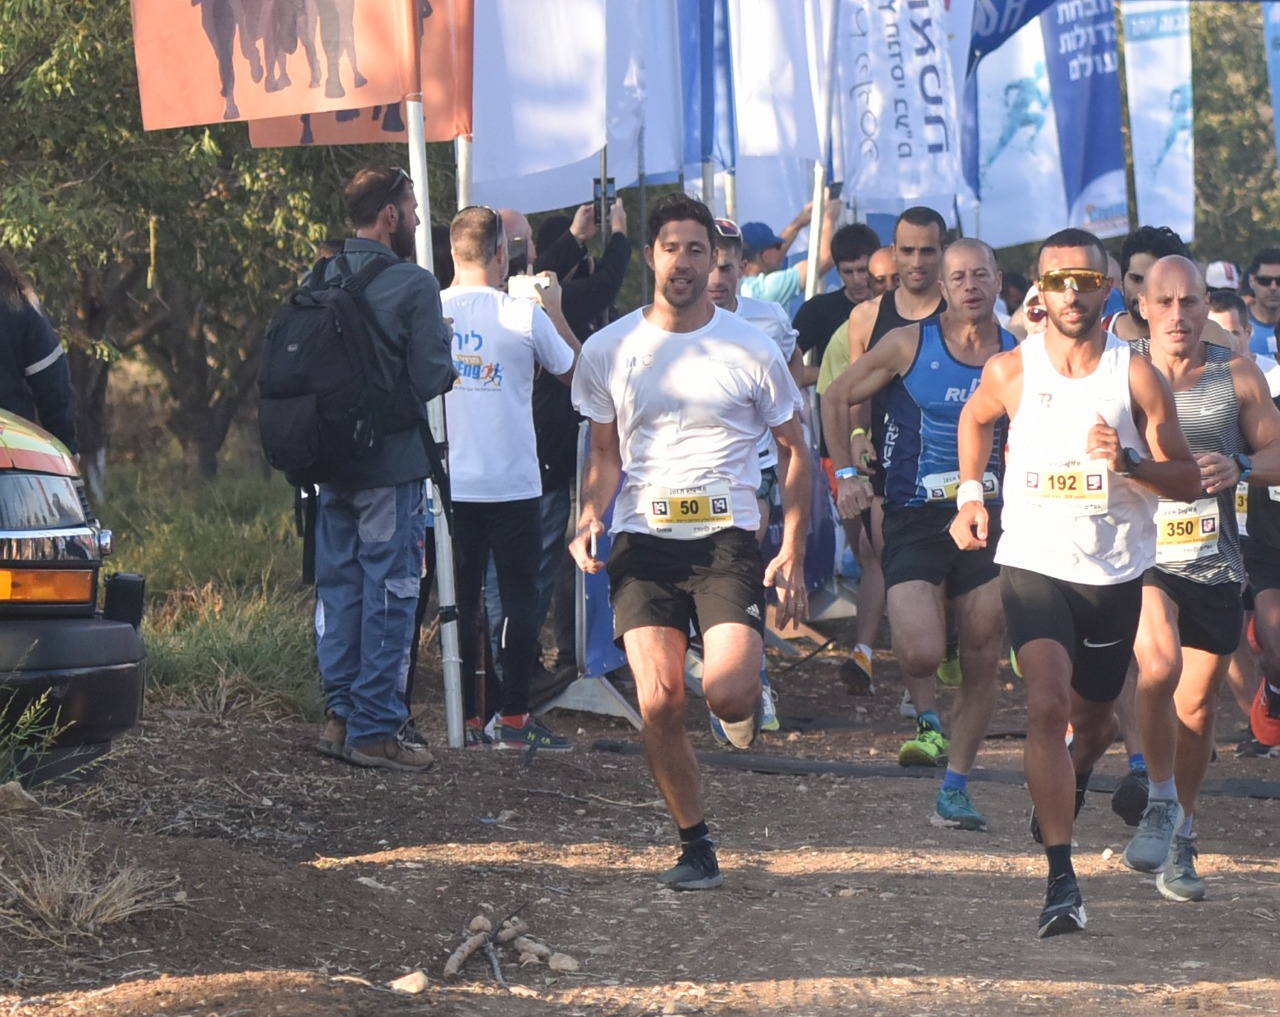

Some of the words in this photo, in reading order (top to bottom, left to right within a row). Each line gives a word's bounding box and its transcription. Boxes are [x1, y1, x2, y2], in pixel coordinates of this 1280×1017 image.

[1048, 474, 1077, 491] 192
[680, 500, 699, 515] 50
[1167, 521, 1194, 537] 350
